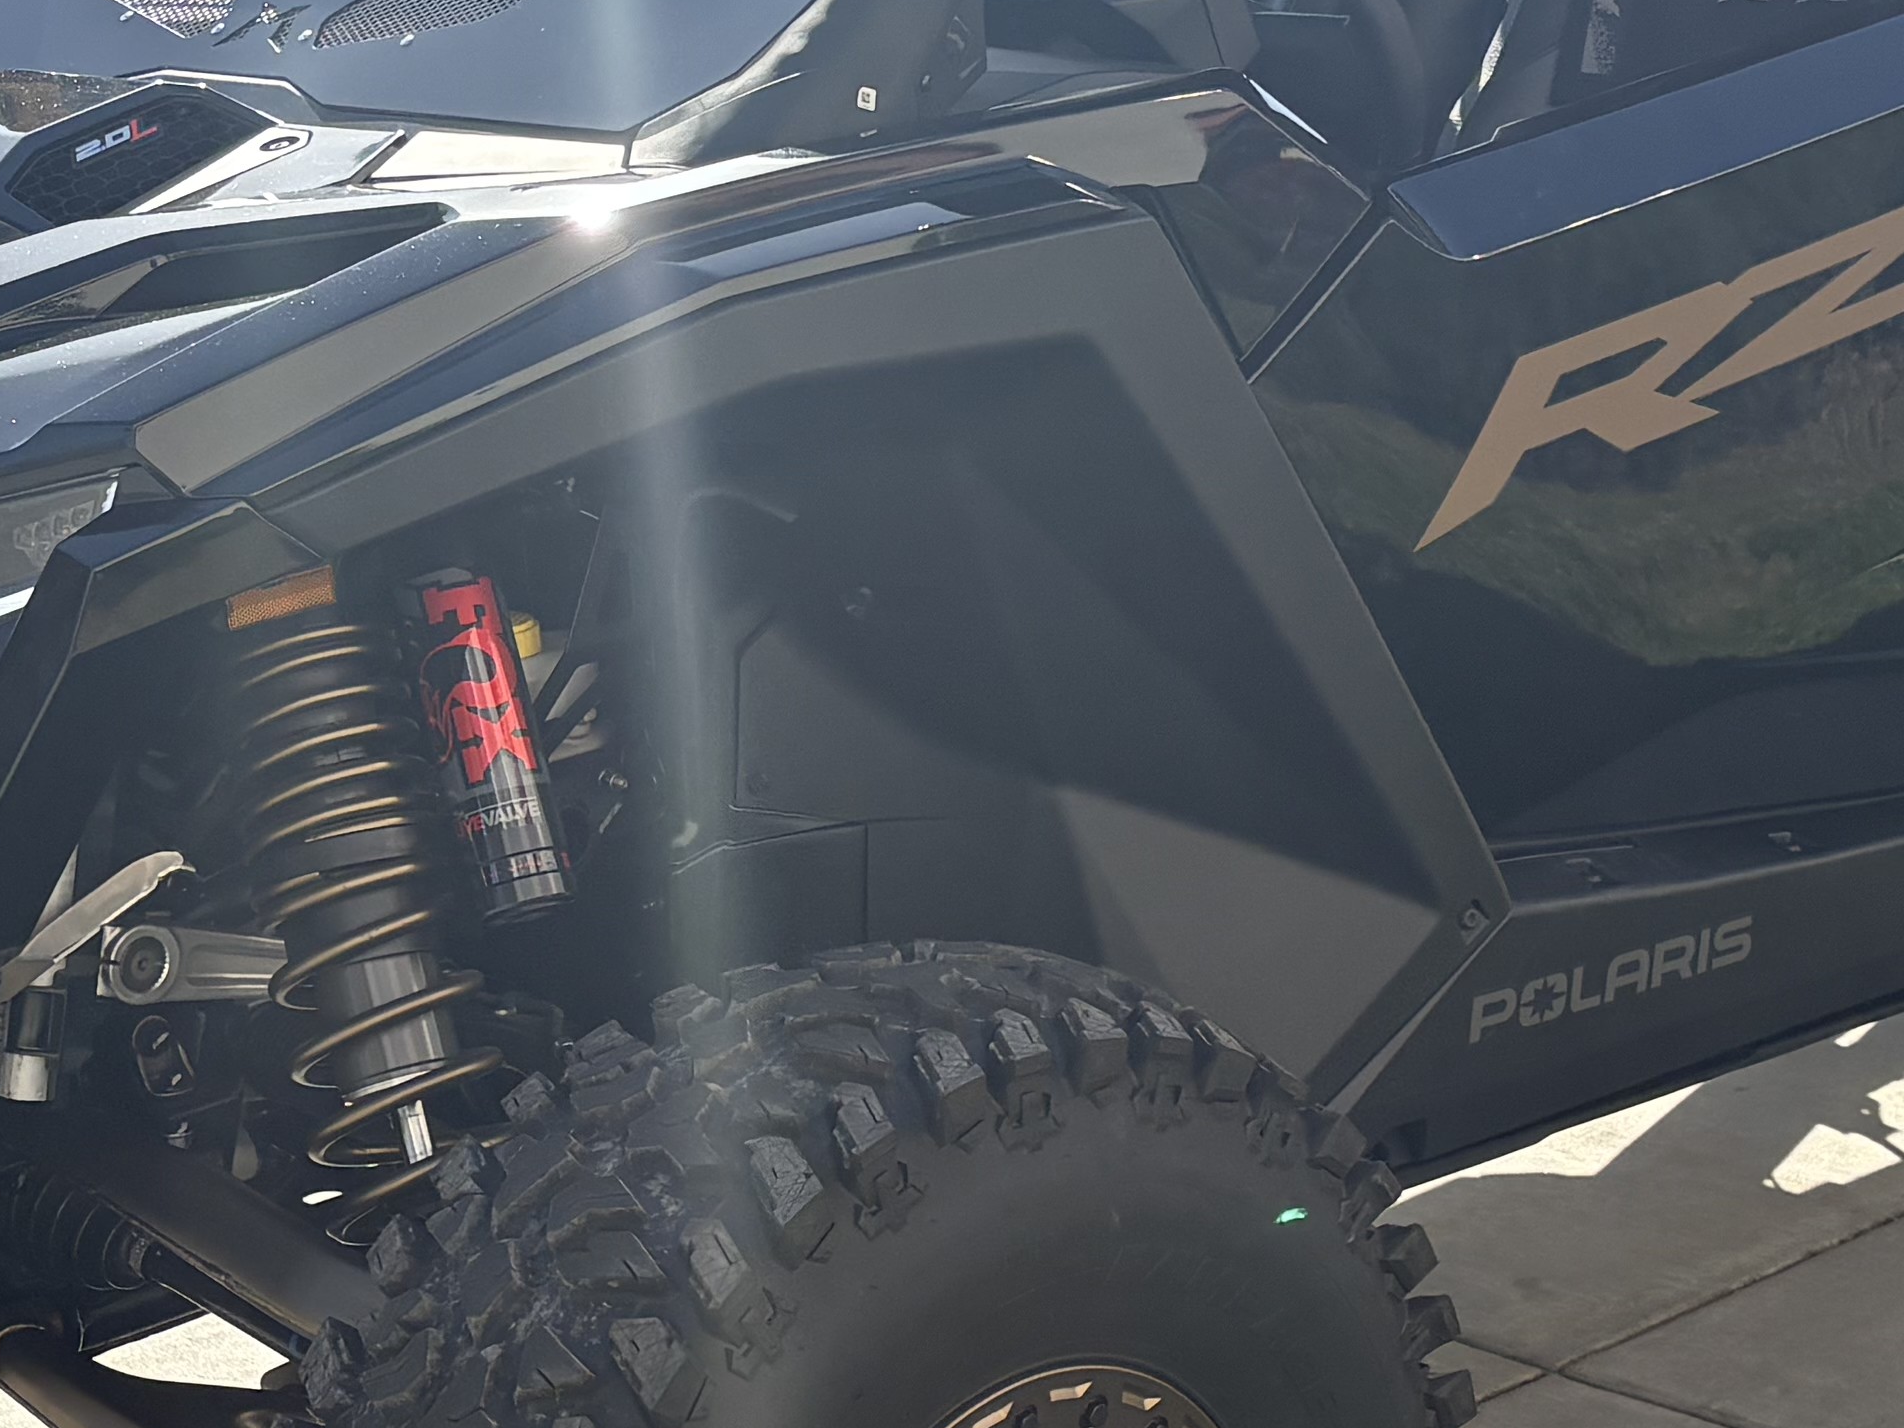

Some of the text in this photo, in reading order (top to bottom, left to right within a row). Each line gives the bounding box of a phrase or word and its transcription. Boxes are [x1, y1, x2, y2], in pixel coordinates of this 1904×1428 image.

[75, 118, 159, 162] 2.0L
[419, 576, 538, 785] FOX
[1468, 915, 1753, 1044] POLARIS
